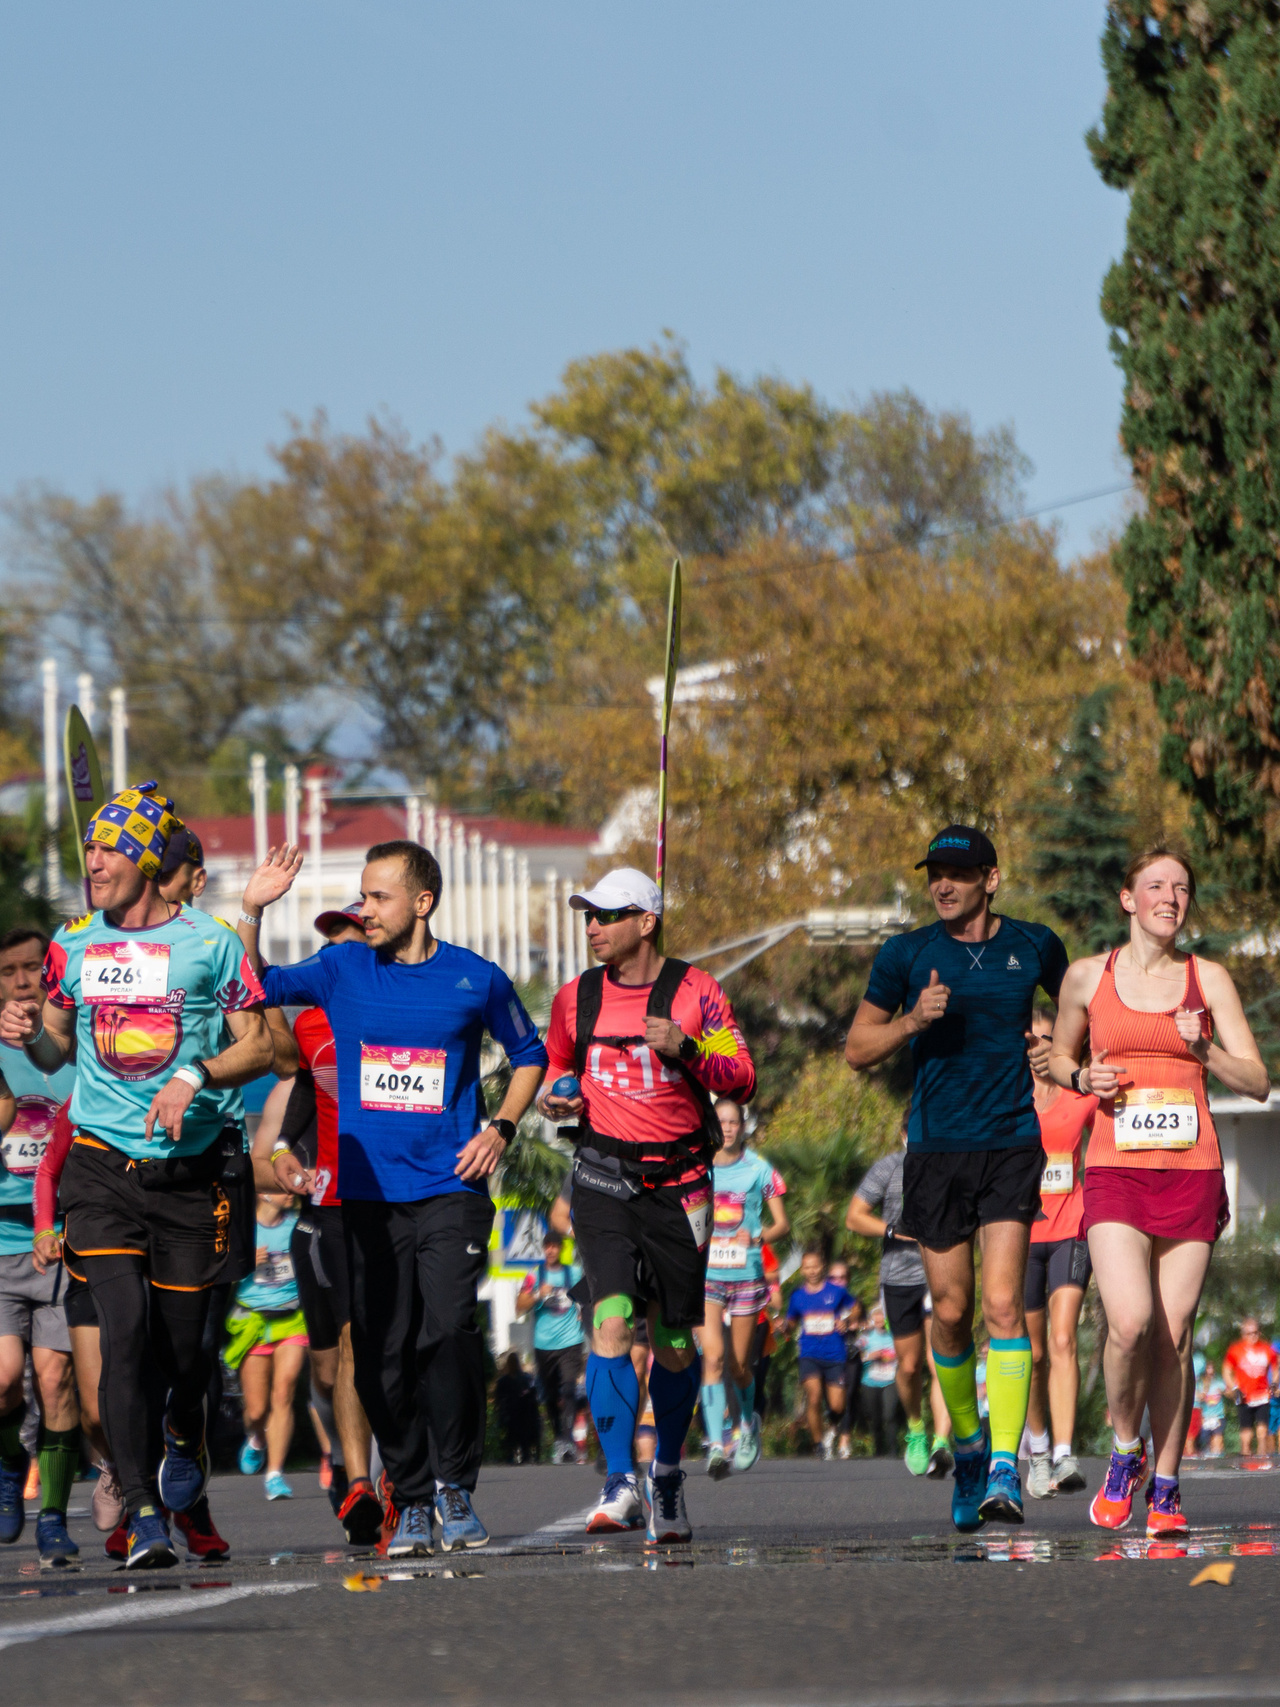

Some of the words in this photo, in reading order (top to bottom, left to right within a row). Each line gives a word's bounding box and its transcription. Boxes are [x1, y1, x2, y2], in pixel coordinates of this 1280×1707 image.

[148, 1006, 183, 1014] MARATHON
[391, 1051, 411, 1062] Sochi
[375, 1073, 425, 1093] 4094
[432, 1078, 440, 1086] 42
[1146, 1090, 1165, 1101] Sochi
[1131, 1112, 1180, 1130] 6623
[581, 1173, 622, 1193] Kalenji
[712, 1249, 737, 1260] 1018
